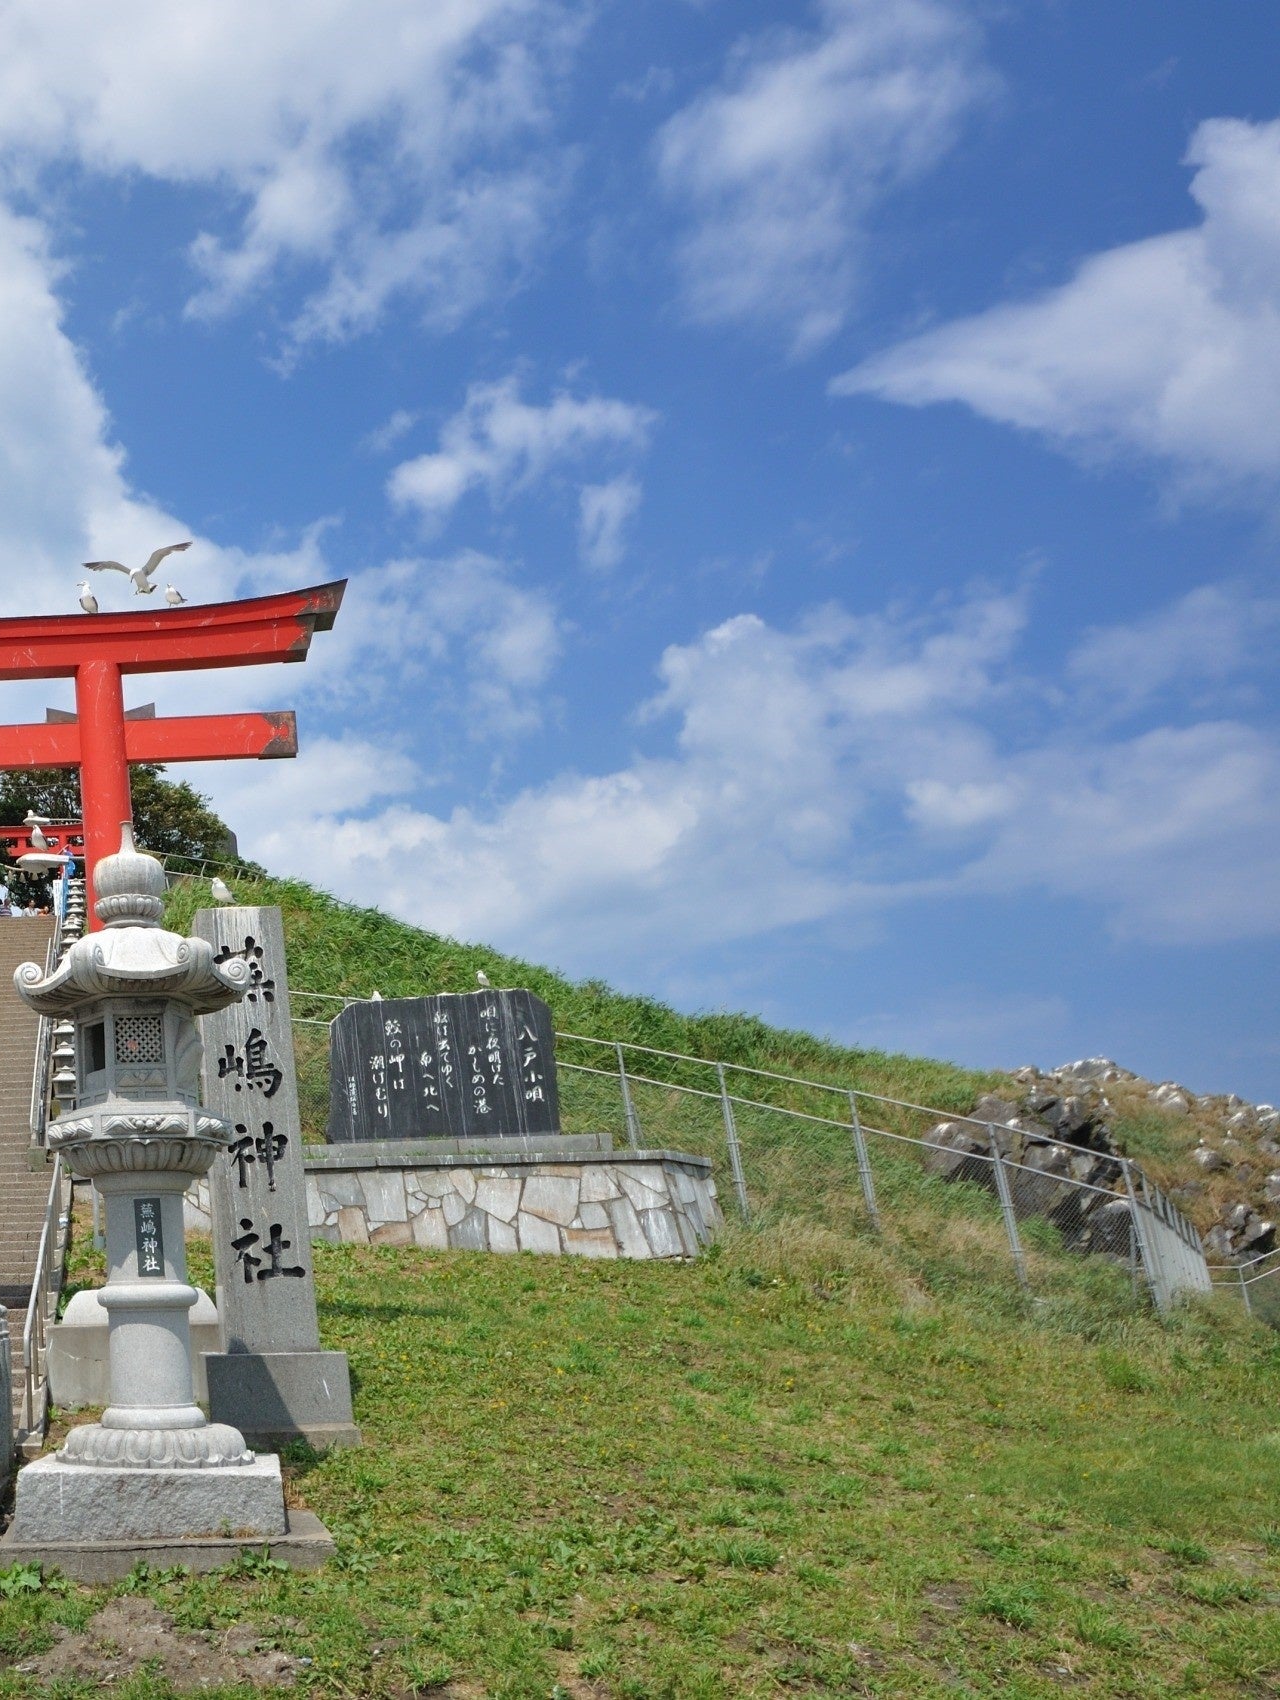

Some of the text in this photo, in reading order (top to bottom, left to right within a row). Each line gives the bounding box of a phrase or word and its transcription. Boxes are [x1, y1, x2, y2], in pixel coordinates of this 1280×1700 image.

[384, 1019, 405, 1090] 鮫の岬は
[480, 1005, 505, 1086] 唄に夜明けた
[517, 1024, 545, 1103] 八戸小唄
[140, 1203, 160, 1272] 蕪嶋神社
